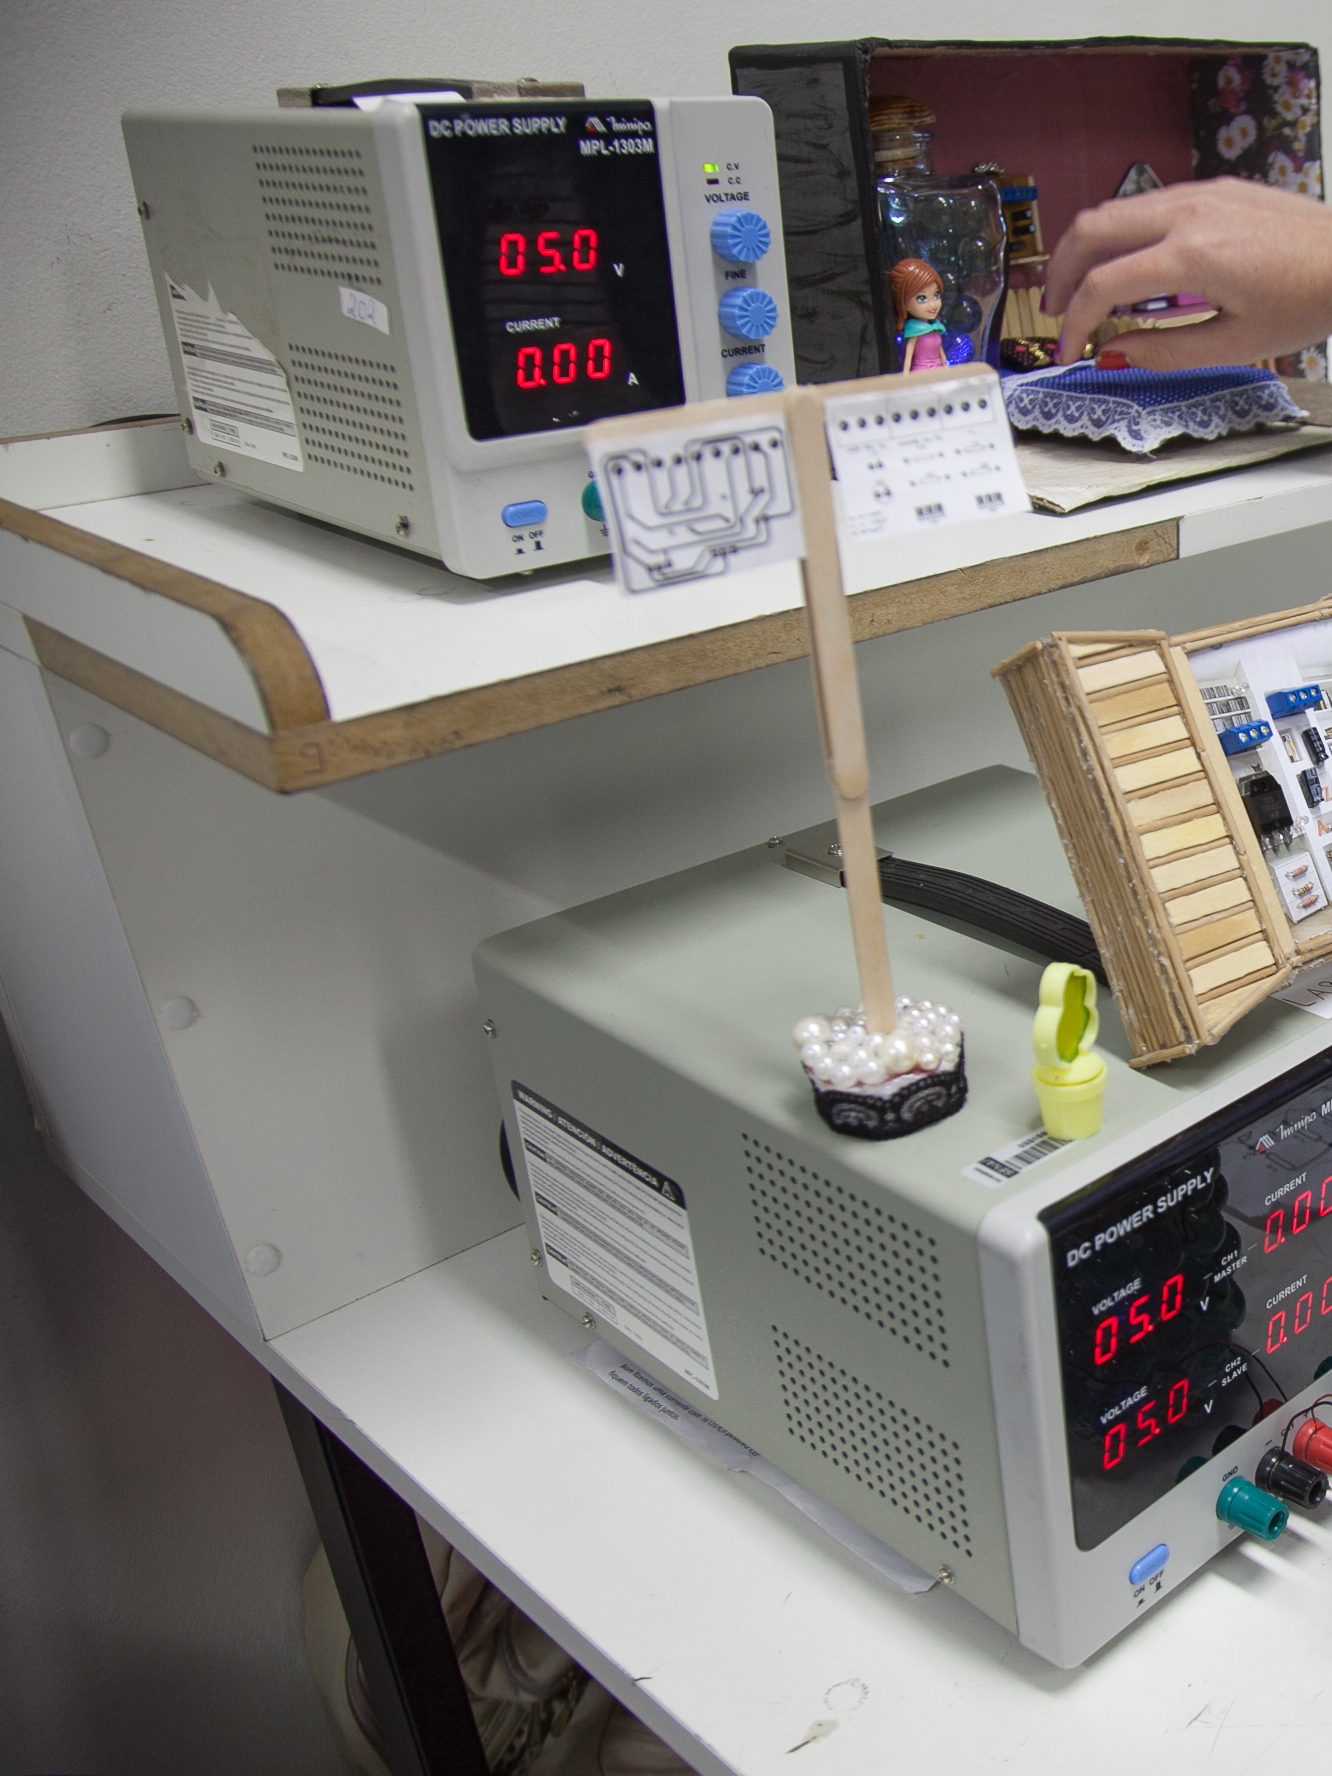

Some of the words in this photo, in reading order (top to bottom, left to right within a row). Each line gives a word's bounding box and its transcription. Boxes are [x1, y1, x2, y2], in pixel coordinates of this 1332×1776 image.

[428, 118, 453, 138] DC
[453, 117, 512, 137] POWER
[512, 116, 567, 135] SUPPLY
[578, 138, 655, 156] MPL-1303M
[704, 191, 750, 204] VOLTAGE
[612, 263, 625, 278] V
[725, 269, 747, 280] FINE
[505, 317, 561, 333] CURRENT
[721, 344, 766, 358] CURRENT
[627, 371, 639, 386] A
[512, 534, 524, 543] ON
[529, 530, 544, 540] OFF
[517, 1089, 553, 1119] WARNING
[1264, 1171, 1309, 1207] CURRENT
[1066, 1241, 1093, 1268] DC
[1094, 1204, 1155, 1252] POWER
[1156, 1167, 1215, 1214] SUPPLY
[1221, 1250, 1238, 1266] CH1
[1213, 1255, 1248, 1283] MASTER
[1091, 1277, 1142, 1316] VOLTAGE
[1266, 1275, 1309, 1310] CURRENT
[1200, 1296, 1210, 1312] V
[1225, 1356, 1241, 1373] CH2
[1221, 1362, 1248, 1387] SLAVE
[1100, 1385, 1149, 1425] VOLTAGE
[1204, 1399, 1214, 1415] V
[1222, 1465, 1238, 1482] GND
[1133, 1584, 1145, 1598] ON
[1149, 1569, 1164, 1586] OFF
